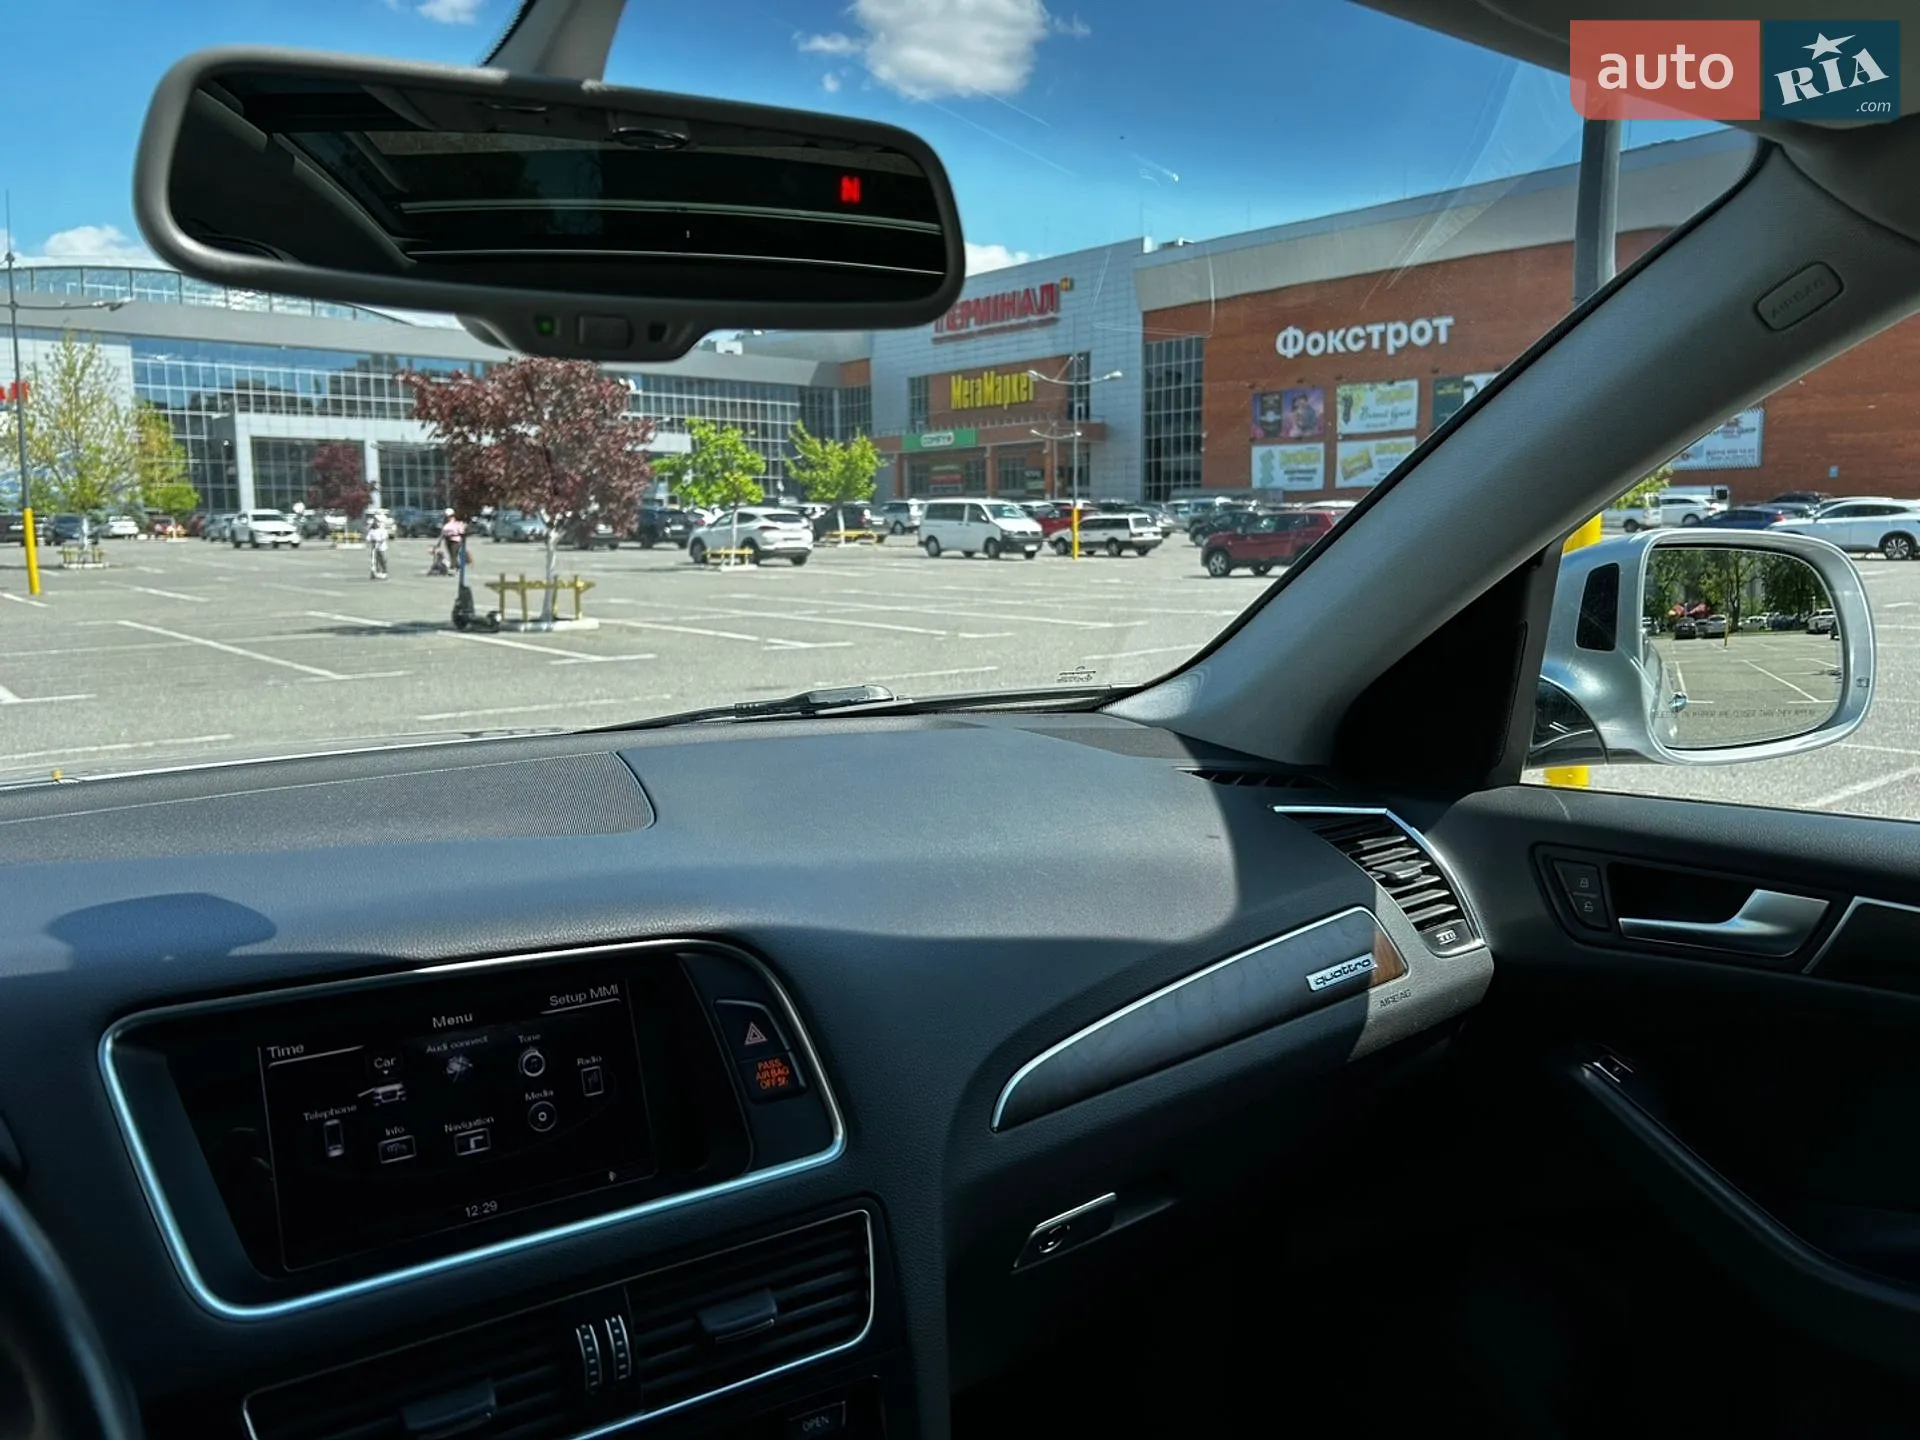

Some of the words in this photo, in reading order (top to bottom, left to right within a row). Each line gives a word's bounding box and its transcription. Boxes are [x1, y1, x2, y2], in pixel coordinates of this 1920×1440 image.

[840, 175, 861, 204] N
[1276, 316, 1454, 359] Фокстрот
[950, 371, 1035, 411] МегаМаркет
[1314, 958, 1372, 986] quattro
[549, 990, 587, 1008] Setup
[589, 984, 619, 1000] MMI
[432, 1012, 474, 1030] Menu
[425, 1043, 448, 1055] Audi
[449, 1034, 489, 1050] connect
[516, 1032, 542, 1044] Tone
[267, 1042, 305, 1059] Time
[373, 1056, 397, 1070] Car
[576, 1054, 603, 1067] Radio
[525, 1087, 554, 1102] Media
[303, 1103, 358, 1122] Telephone
[385, 1124, 405, 1137] Info
[444, 1115, 495, 1133] Navigation
[464, 1200, 499, 1218] 12:29
